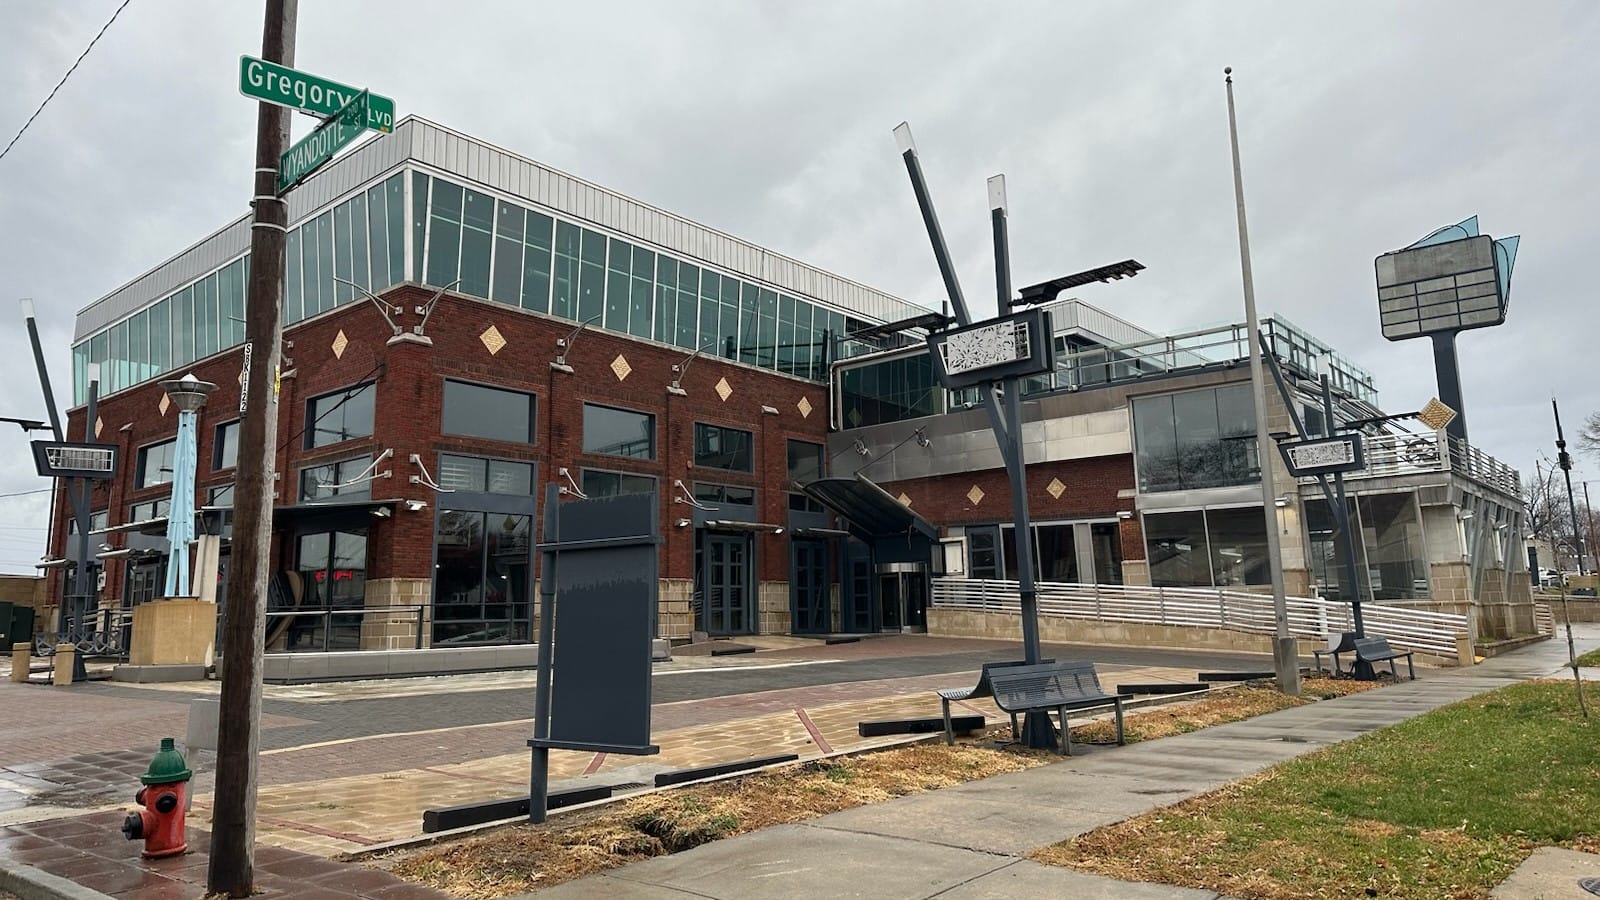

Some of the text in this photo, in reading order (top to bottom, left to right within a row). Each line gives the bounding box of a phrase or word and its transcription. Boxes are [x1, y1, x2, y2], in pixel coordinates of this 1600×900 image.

[247, 61, 392, 126] Gregory LVD
[282, 114, 361, 183] WYANDOTTE ST
